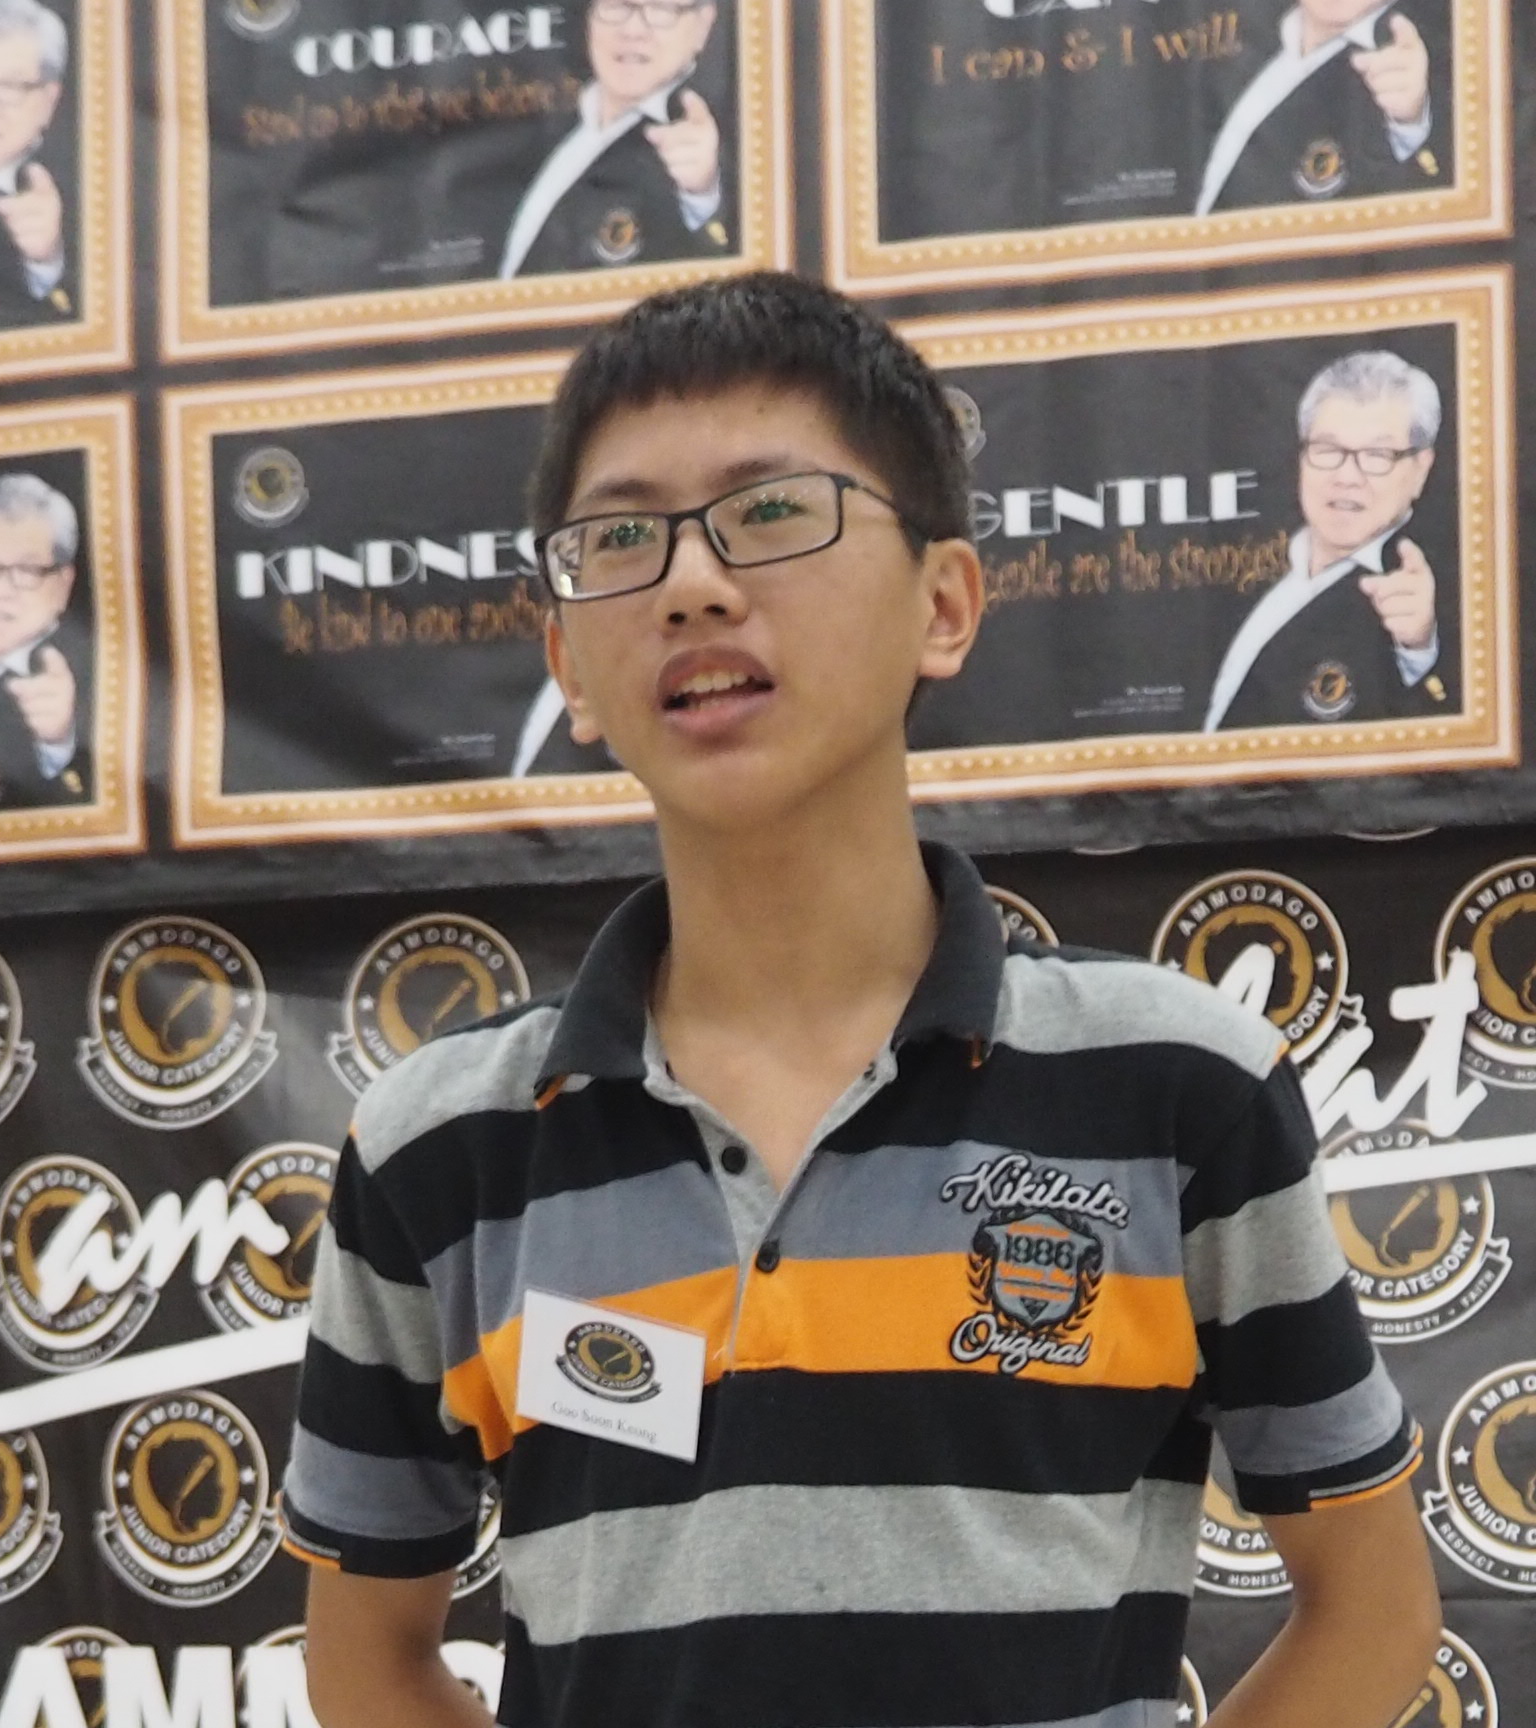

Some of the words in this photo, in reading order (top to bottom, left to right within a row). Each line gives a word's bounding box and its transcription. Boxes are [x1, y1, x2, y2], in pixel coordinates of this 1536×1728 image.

[293, 5, 565, 77] COURAGE
[964, 47, 1046, 80] can
[1152, 12, 1243, 63] will
[1180, 885, 1320, 936] AMMODAGO
[1382, 1229, 1474, 1297] CATEGORY
[951, 1312, 1093, 1374] Original
[1457, 1482, 1521, 1541] JUNIOR
[1439, 1523, 1495, 1571] RESPECT
